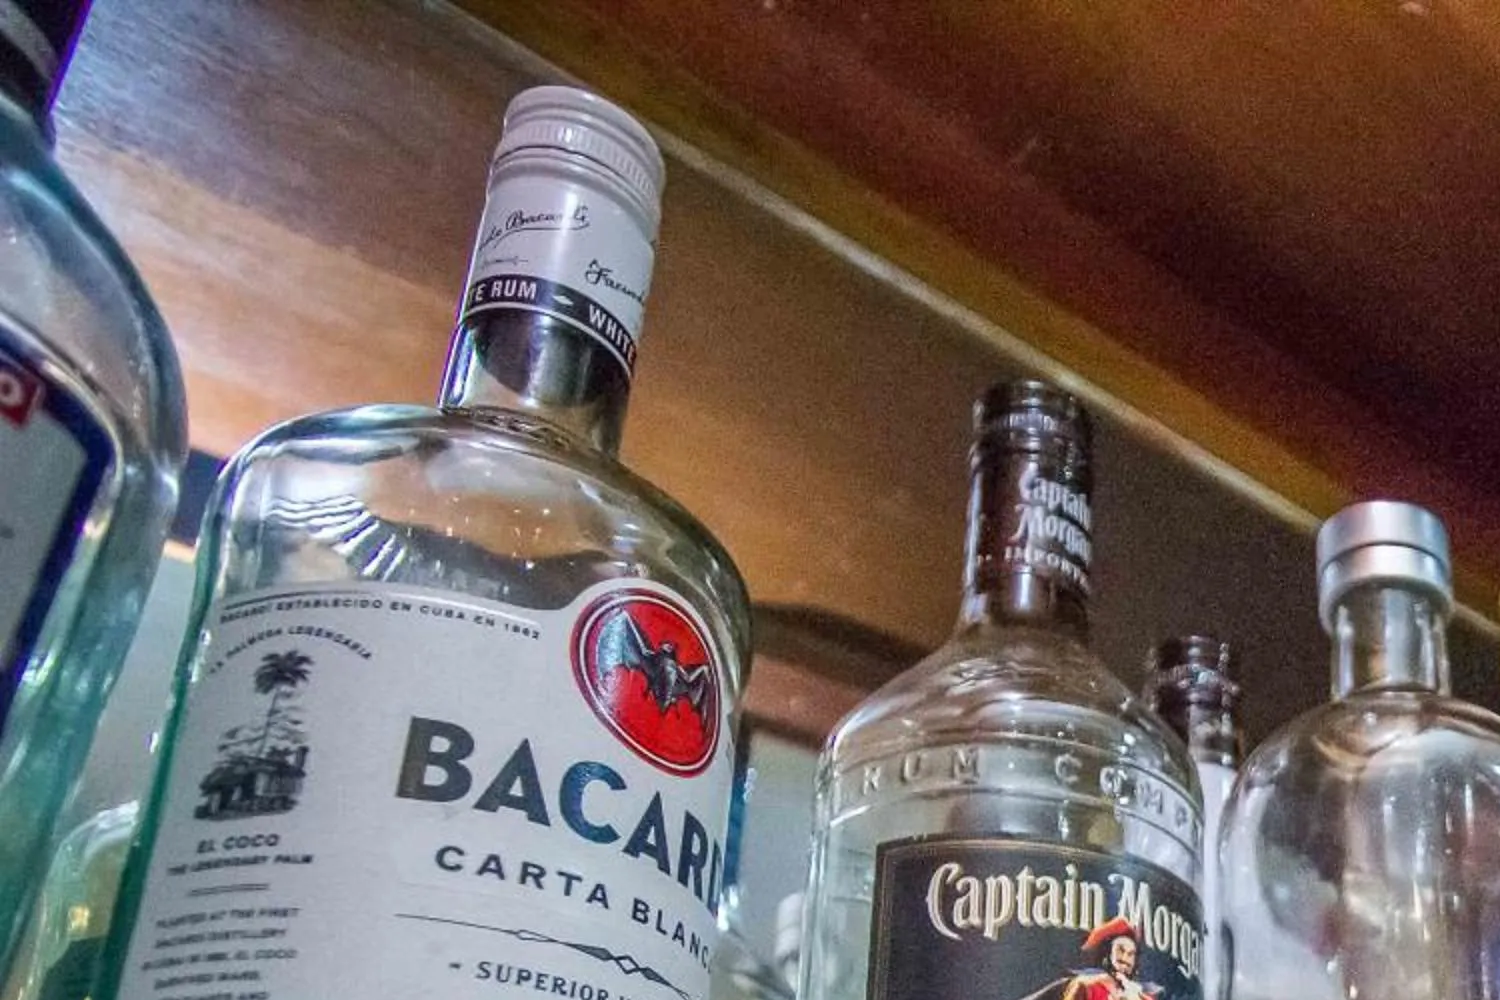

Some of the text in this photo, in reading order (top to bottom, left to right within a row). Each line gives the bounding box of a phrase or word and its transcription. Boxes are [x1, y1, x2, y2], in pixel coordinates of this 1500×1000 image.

[491, 278, 537, 300] RUM
[588, 303, 637, 364] WHITE
[390, 601, 411, 612] EN
[420, 604, 466, 620] CUBA
[222, 833, 281, 850] COCO
[434, 844, 712, 974] CARTA BLANC
[925, 861, 1105, 942] Captain
